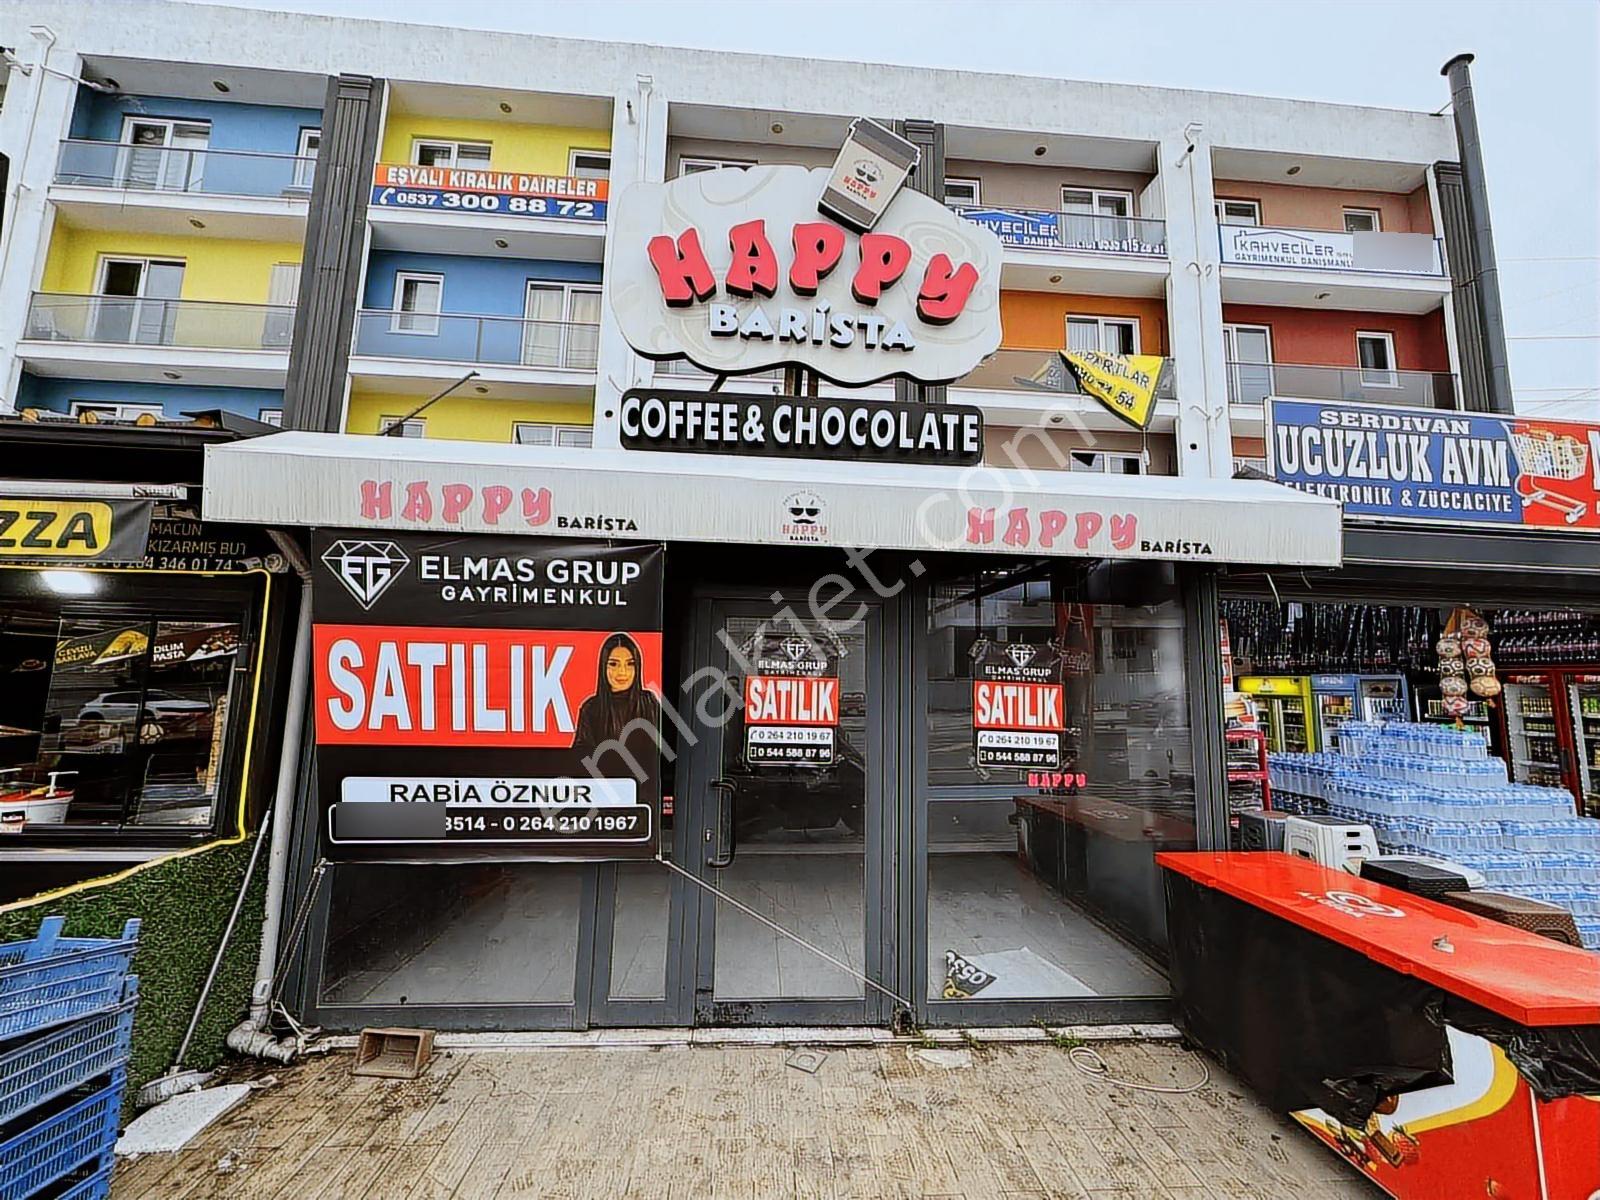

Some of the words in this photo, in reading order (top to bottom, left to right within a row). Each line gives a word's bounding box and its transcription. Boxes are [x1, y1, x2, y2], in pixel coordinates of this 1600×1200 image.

[387, 166, 444, 185] EŞYALI
[449, 169, 514, 192] KİRALIK
[518, 174, 597, 197] DAİRELER
[396, 192, 438, 206] 0537
[442, 193, 499, 211] 300
[508, 197, 547, 214] 88
[556, 200, 594, 217] 72
[968, 218, 1058, 237] HVECİLER
[1239, 239, 1334, 257] KAHVECİLER
[646, 218, 981, 326] HAPPY
[709, 299, 916, 352] BARİSTA
[772, 404, 979, 454] CHOCOLATE
[1319, 410, 1471, 436] SERDİVAN
[1277, 425, 1433, 484] UCUZLUK
[1442, 437, 1511, 488] AVM
[360, 479, 553, 527] HAPPY
[1401, 489, 1414, 507] &
[1418, 489, 1514, 513] ZÜCCACİYE
[150, 522, 202, 536] MACUN
[966, 506, 1138, 551] HAPPY
[421, 555, 536, 583] ELMAS
[546, 560, 641, 585] GRUP
[441, 584, 628, 606] GAYRİMENKUL
[985, 665, 1020, 675] ELMAS
[326, 638, 577, 733] SATILIK
[748, 679, 835, 722] SATILIK
[977, 684, 1059, 728] SATILIK
[390, 779, 482, 803] RABİA
[490, 780, 593, 804] ÖZNUR
[519, 816, 554, 831] 264
[559, 816, 591, 831] 210
[595, 816, 638, 831] 1967
